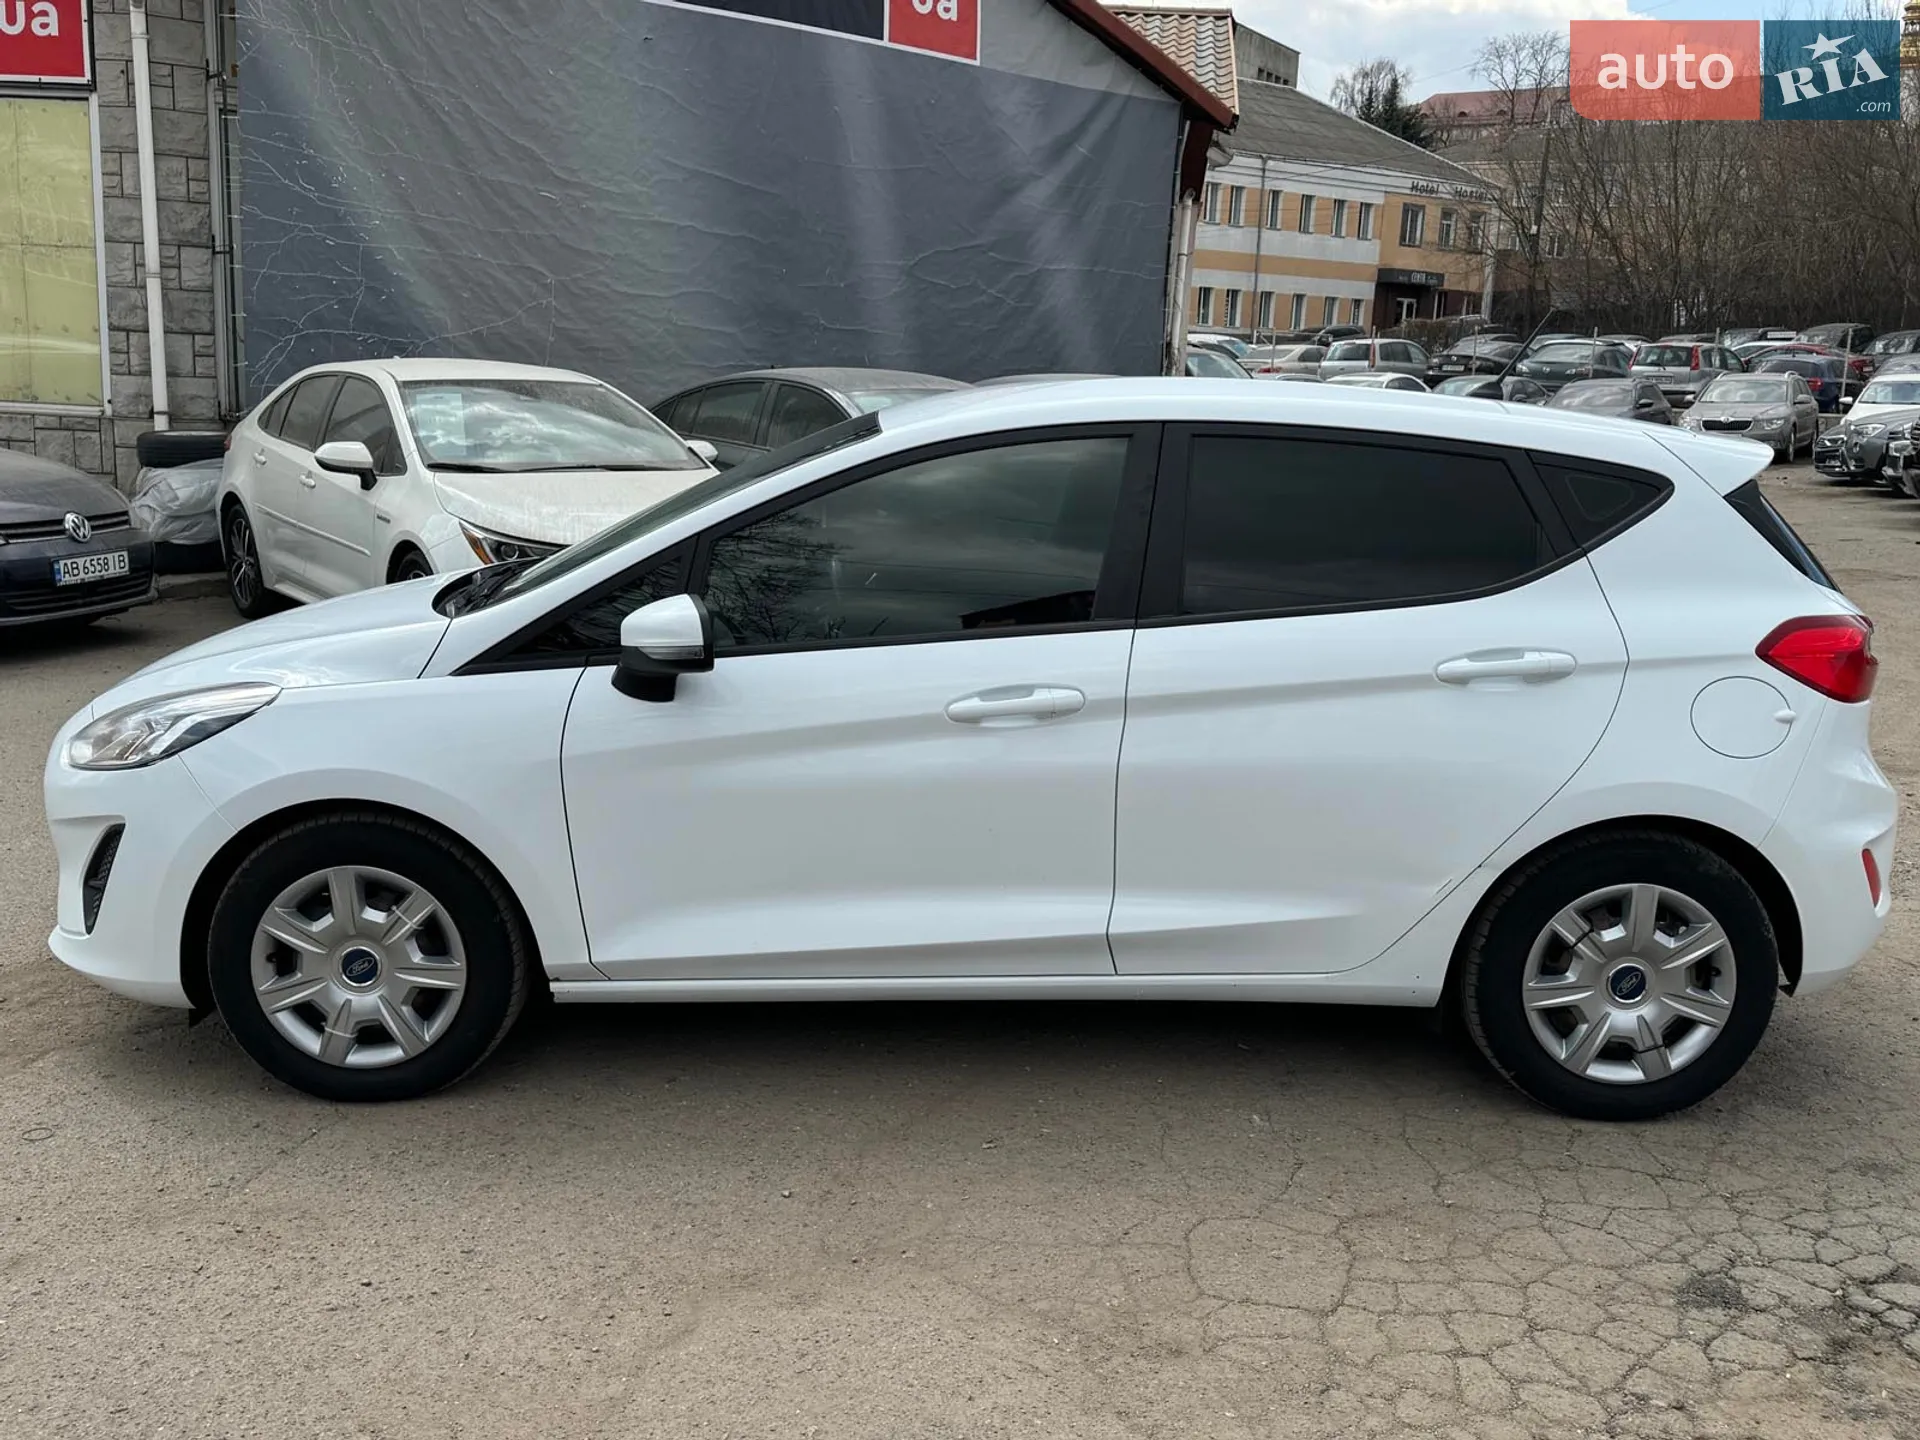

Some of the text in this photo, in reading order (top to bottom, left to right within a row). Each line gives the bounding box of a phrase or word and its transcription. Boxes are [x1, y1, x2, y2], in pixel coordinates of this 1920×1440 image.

[0, 0, 59, 36] ua
[1410, 180, 1440, 196] Hotel
[62, 554, 127, 579] AB 6558 IB
